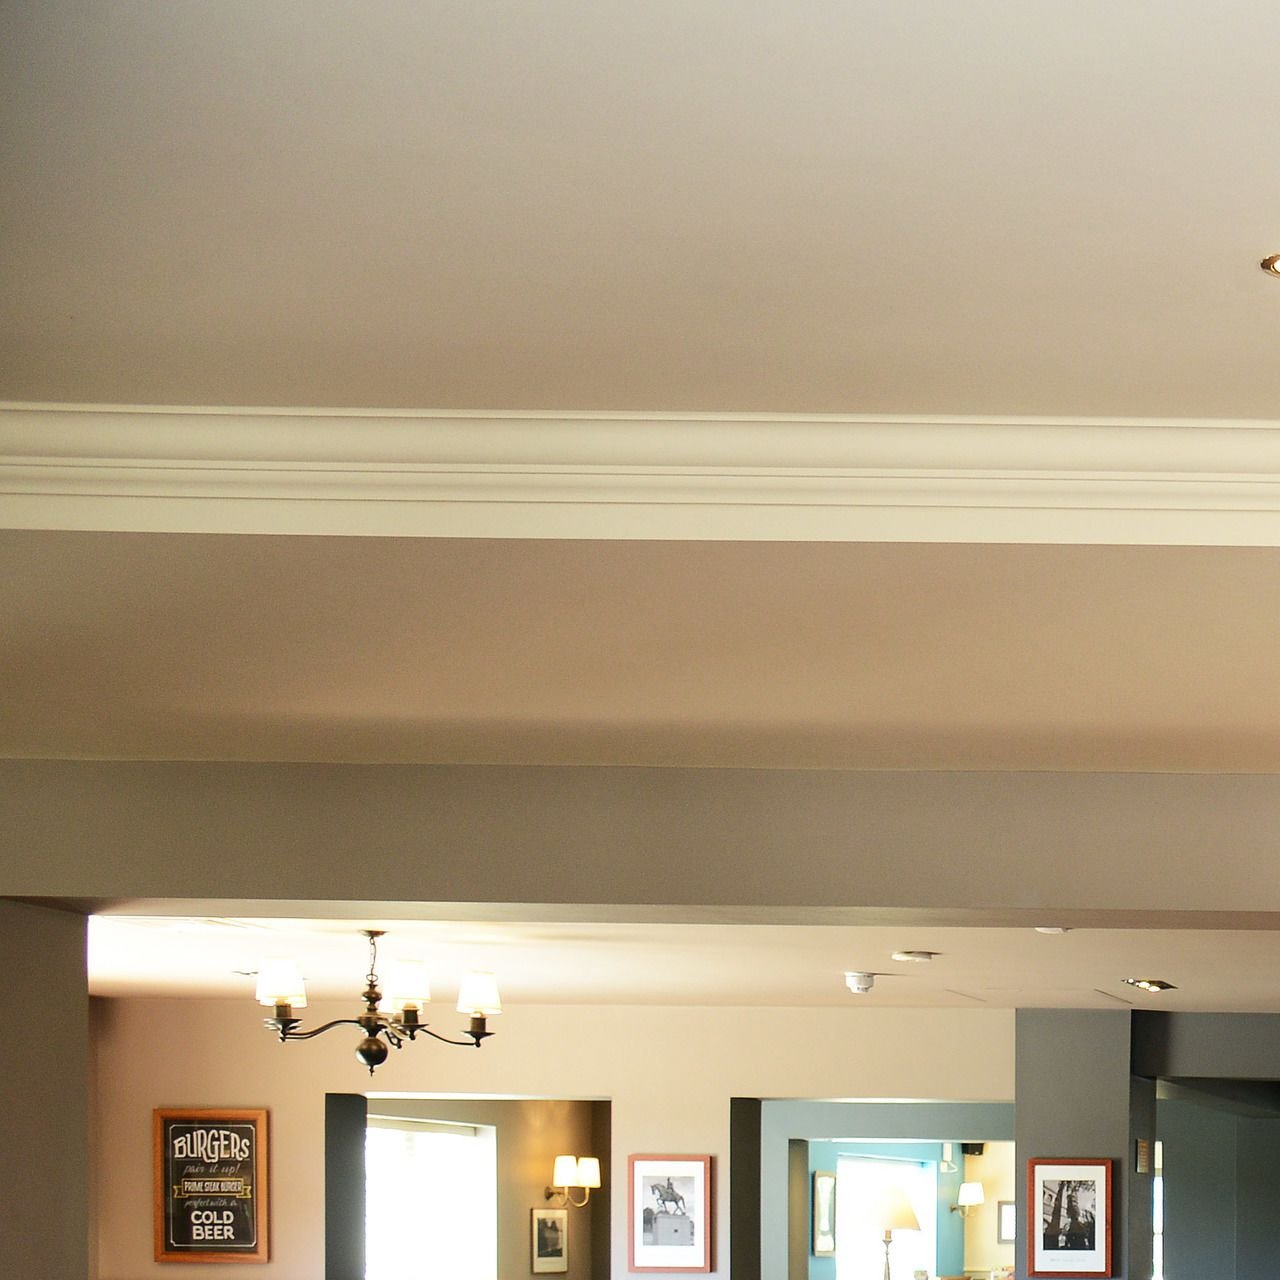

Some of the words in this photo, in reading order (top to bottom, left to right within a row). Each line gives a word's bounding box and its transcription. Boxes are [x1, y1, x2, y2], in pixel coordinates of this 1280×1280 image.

[173, 1129, 250, 1163] BURGERS
[183, 1164, 204, 1176] pair
[221, 1163, 241, 1176] up!
[184, 1181, 204, 1192] PRIME
[191, 1210, 235, 1224] COLD
[192, 1225, 235, 1240] BEER
